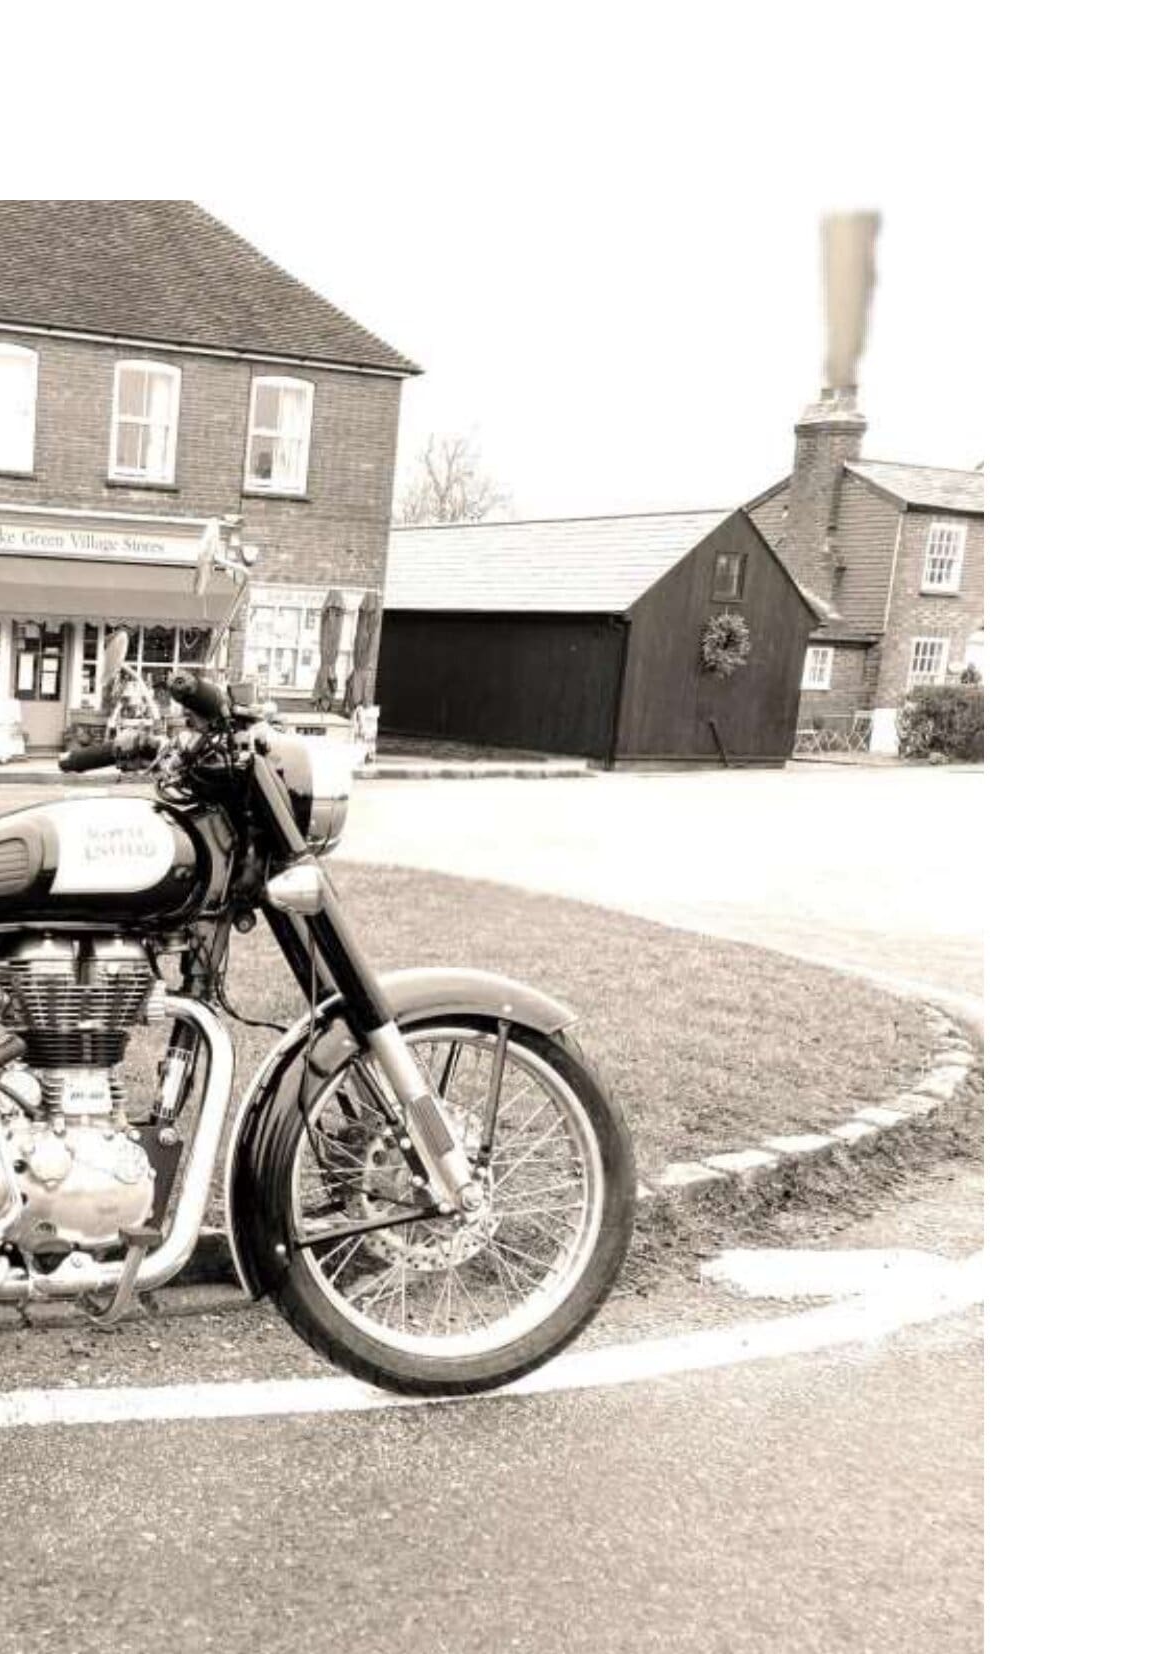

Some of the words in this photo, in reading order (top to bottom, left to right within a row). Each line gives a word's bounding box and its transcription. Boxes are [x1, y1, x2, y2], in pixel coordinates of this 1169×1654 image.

[22, 530, 64, 548] Green
[69, 532, 118, 553] Village
[122, 538, 165, 553] Stores
